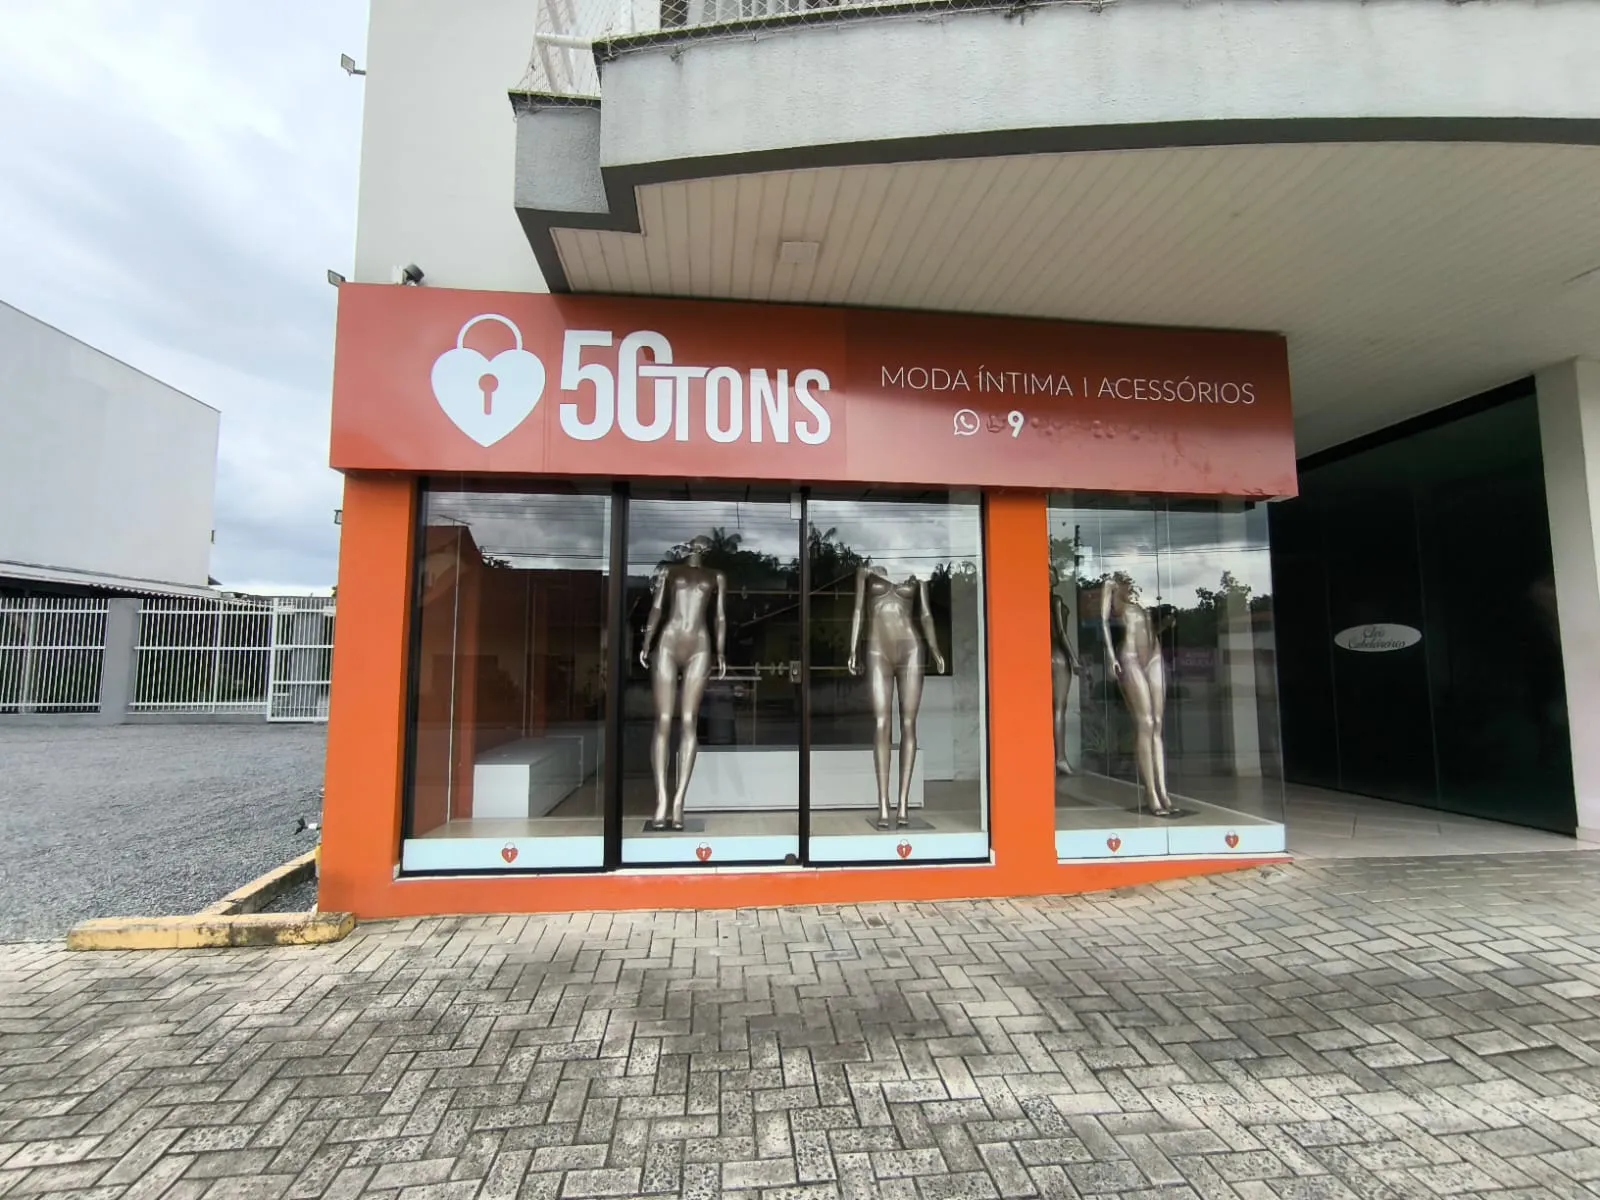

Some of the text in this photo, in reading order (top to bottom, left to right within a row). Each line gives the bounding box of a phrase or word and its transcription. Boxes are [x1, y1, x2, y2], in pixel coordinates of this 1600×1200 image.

[880, 365, 971, 392] MODA
[978, 364, 1074, 398] ÍNTIMA
[1097, 375, 1256, 405] ACESSÓRIOS
